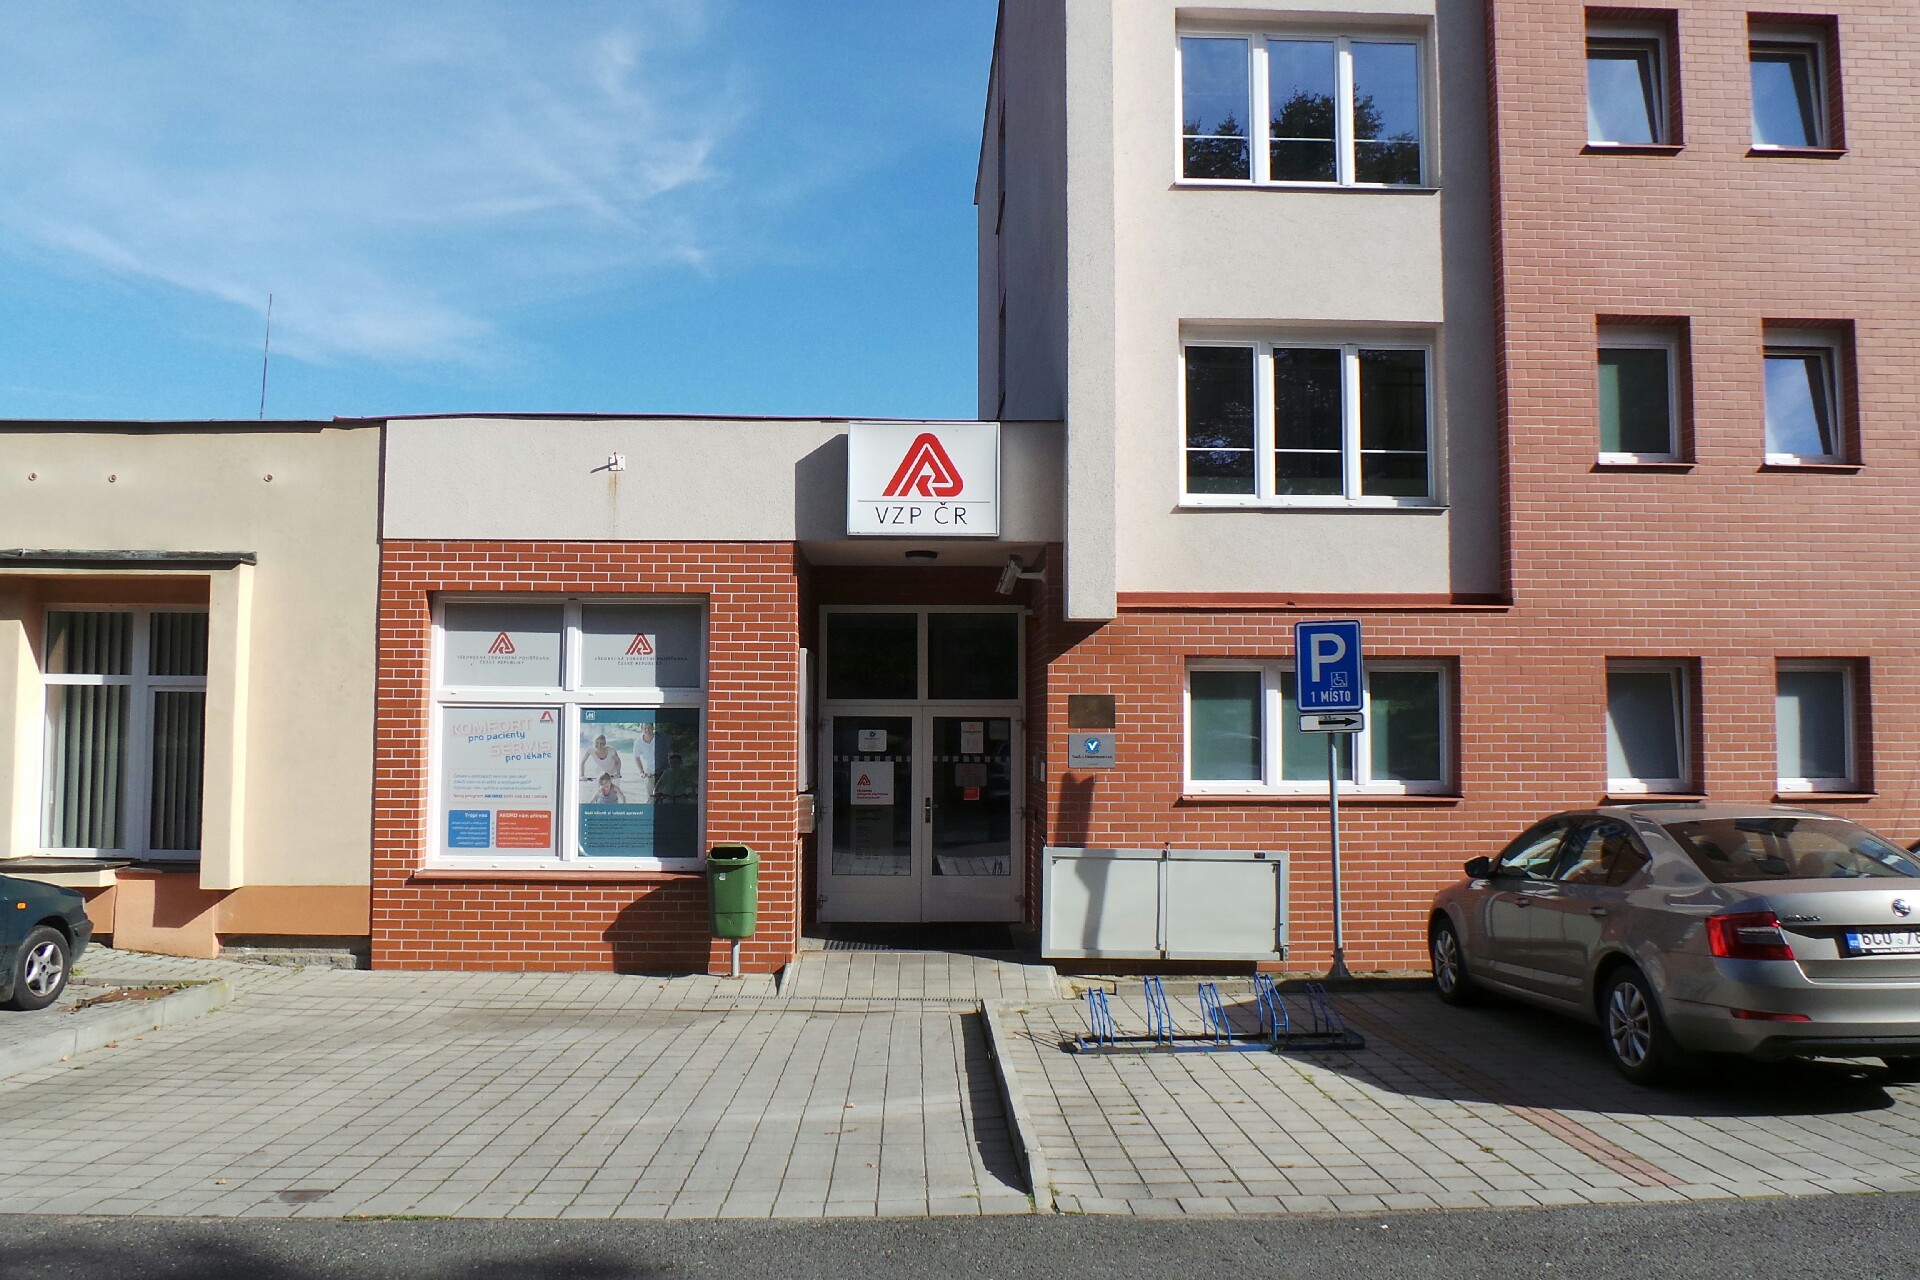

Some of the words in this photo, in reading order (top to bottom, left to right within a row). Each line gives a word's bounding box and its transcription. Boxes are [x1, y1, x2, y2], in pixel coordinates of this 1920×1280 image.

[875, 506, 922, 525] VZP
[934, 502, 968, 525] ČR
[1310, 632, 1346, 682] P
[1311, 691, 1316, 703] 1
[1320, 688, 1351, 703] MÍSTO
[452, 718, 532, 736] KOMFORT
[468, 735, 484, 743] pro
[486, 731, 525, 742] pacienty
[490, 740, 552, 757] SERVIS
[505, 754, 521, 763] pro
